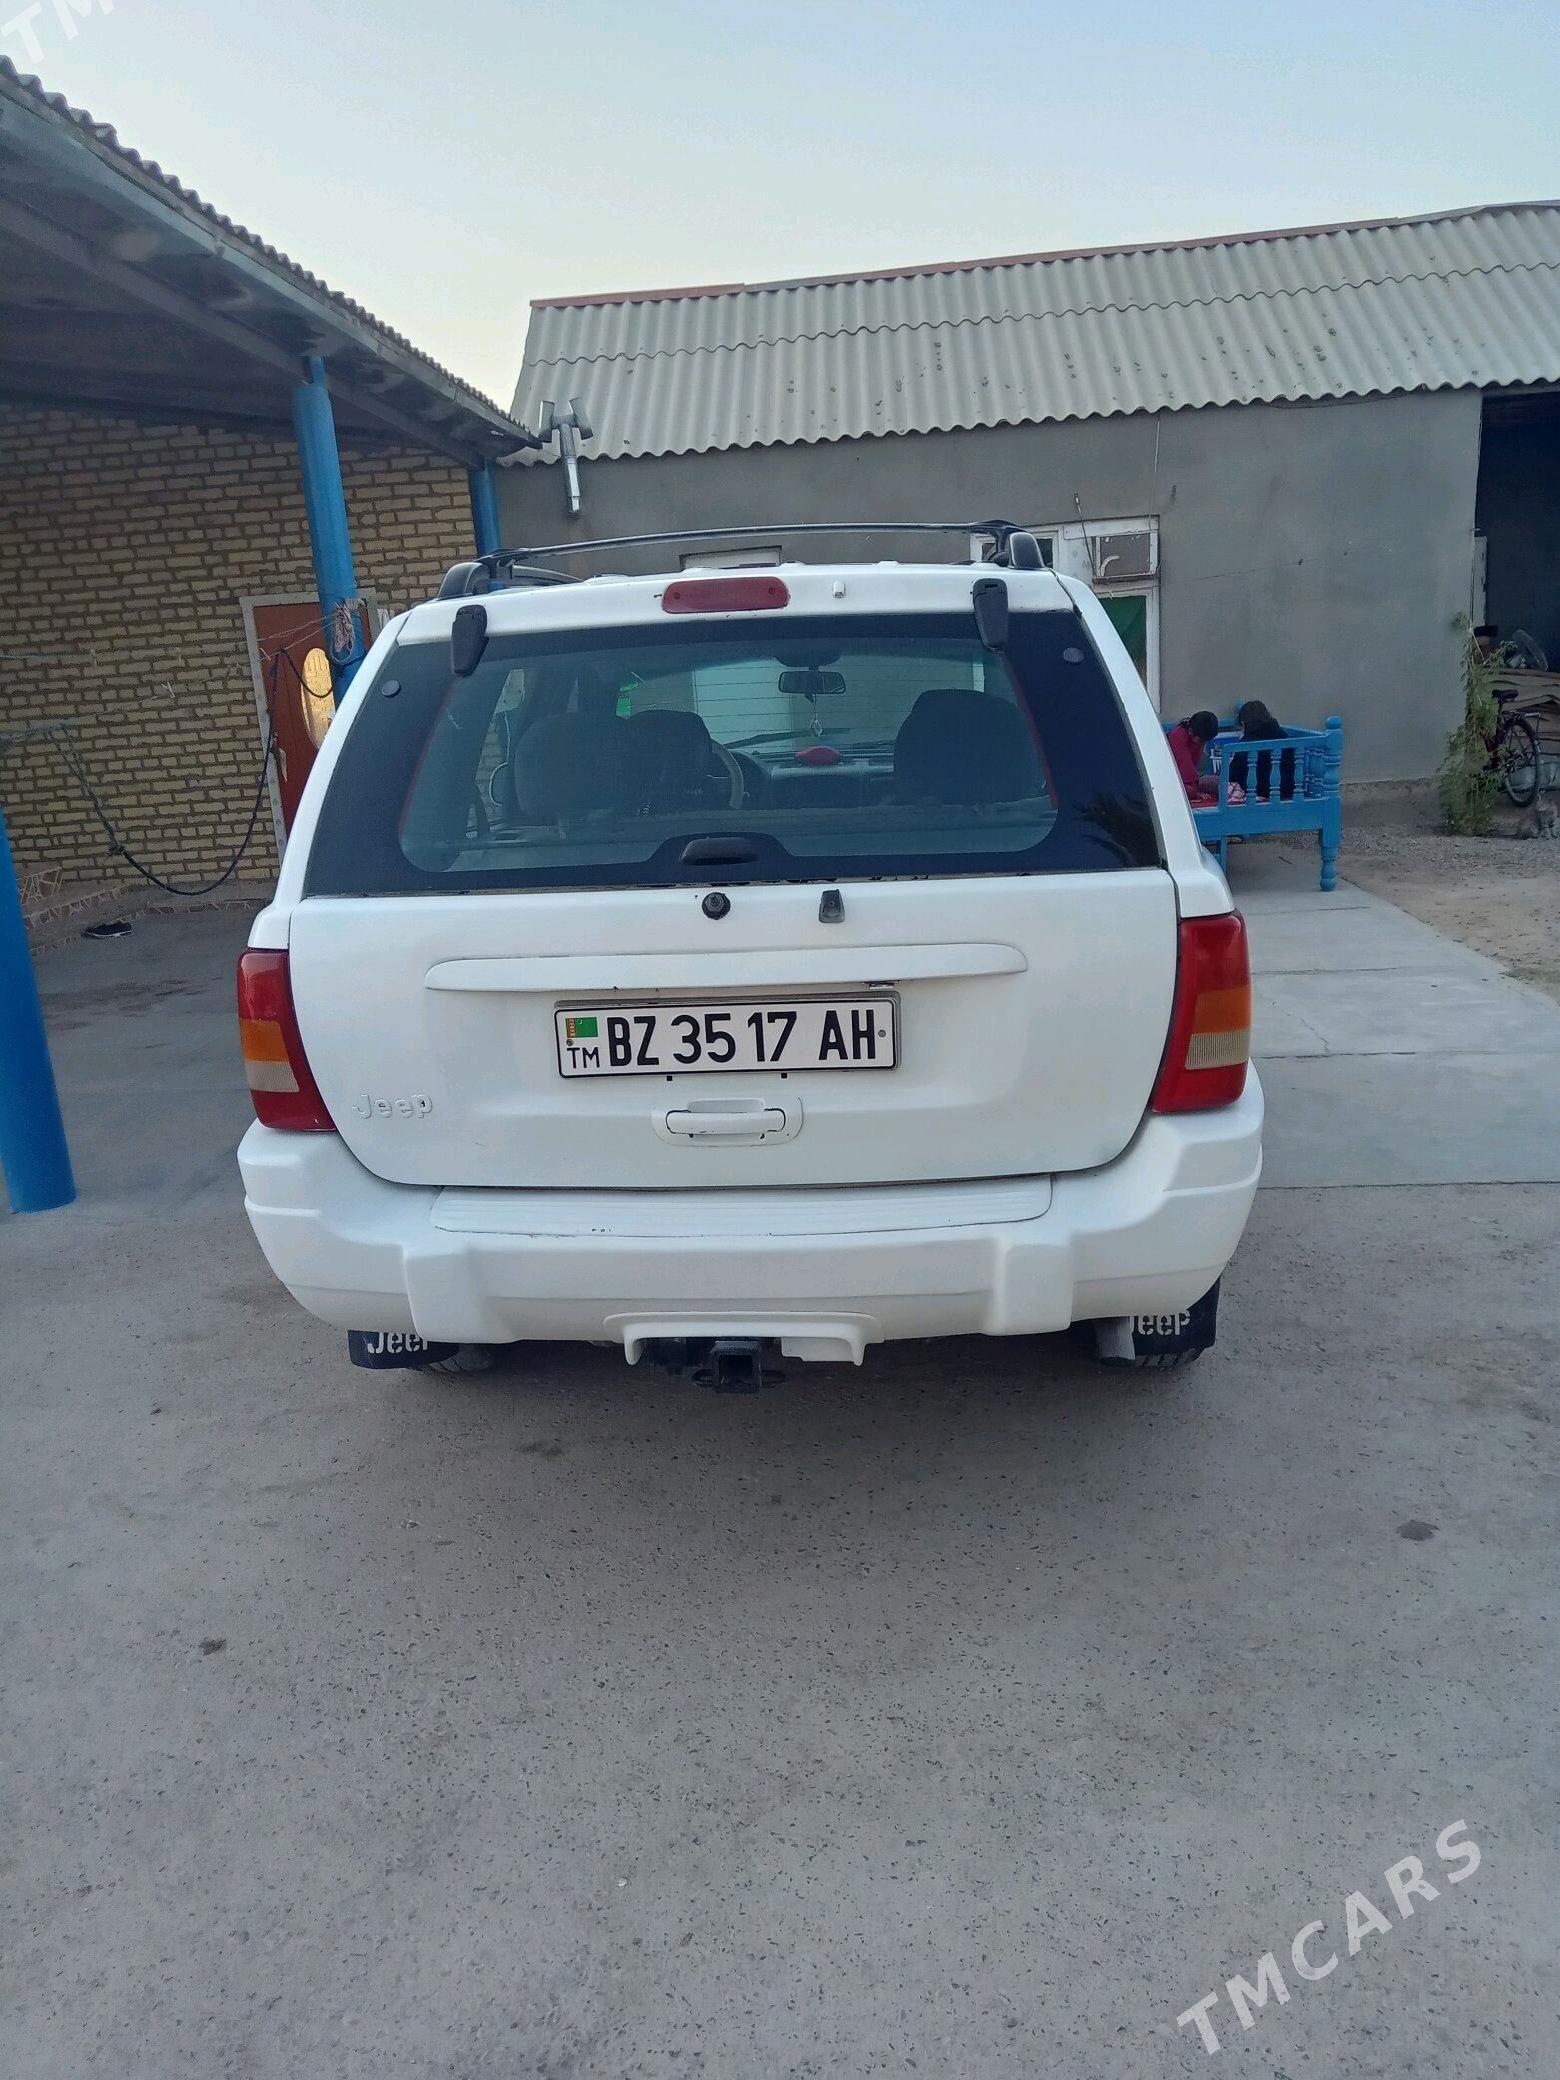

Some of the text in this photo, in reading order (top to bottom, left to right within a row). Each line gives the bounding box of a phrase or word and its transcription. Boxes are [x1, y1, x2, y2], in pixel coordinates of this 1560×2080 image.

[607, 1009, 876, 1067] BZ 35 17 AH
[566, 1047, 600, 1069] TM
[352, 1094, 432, 1119] Jeep
